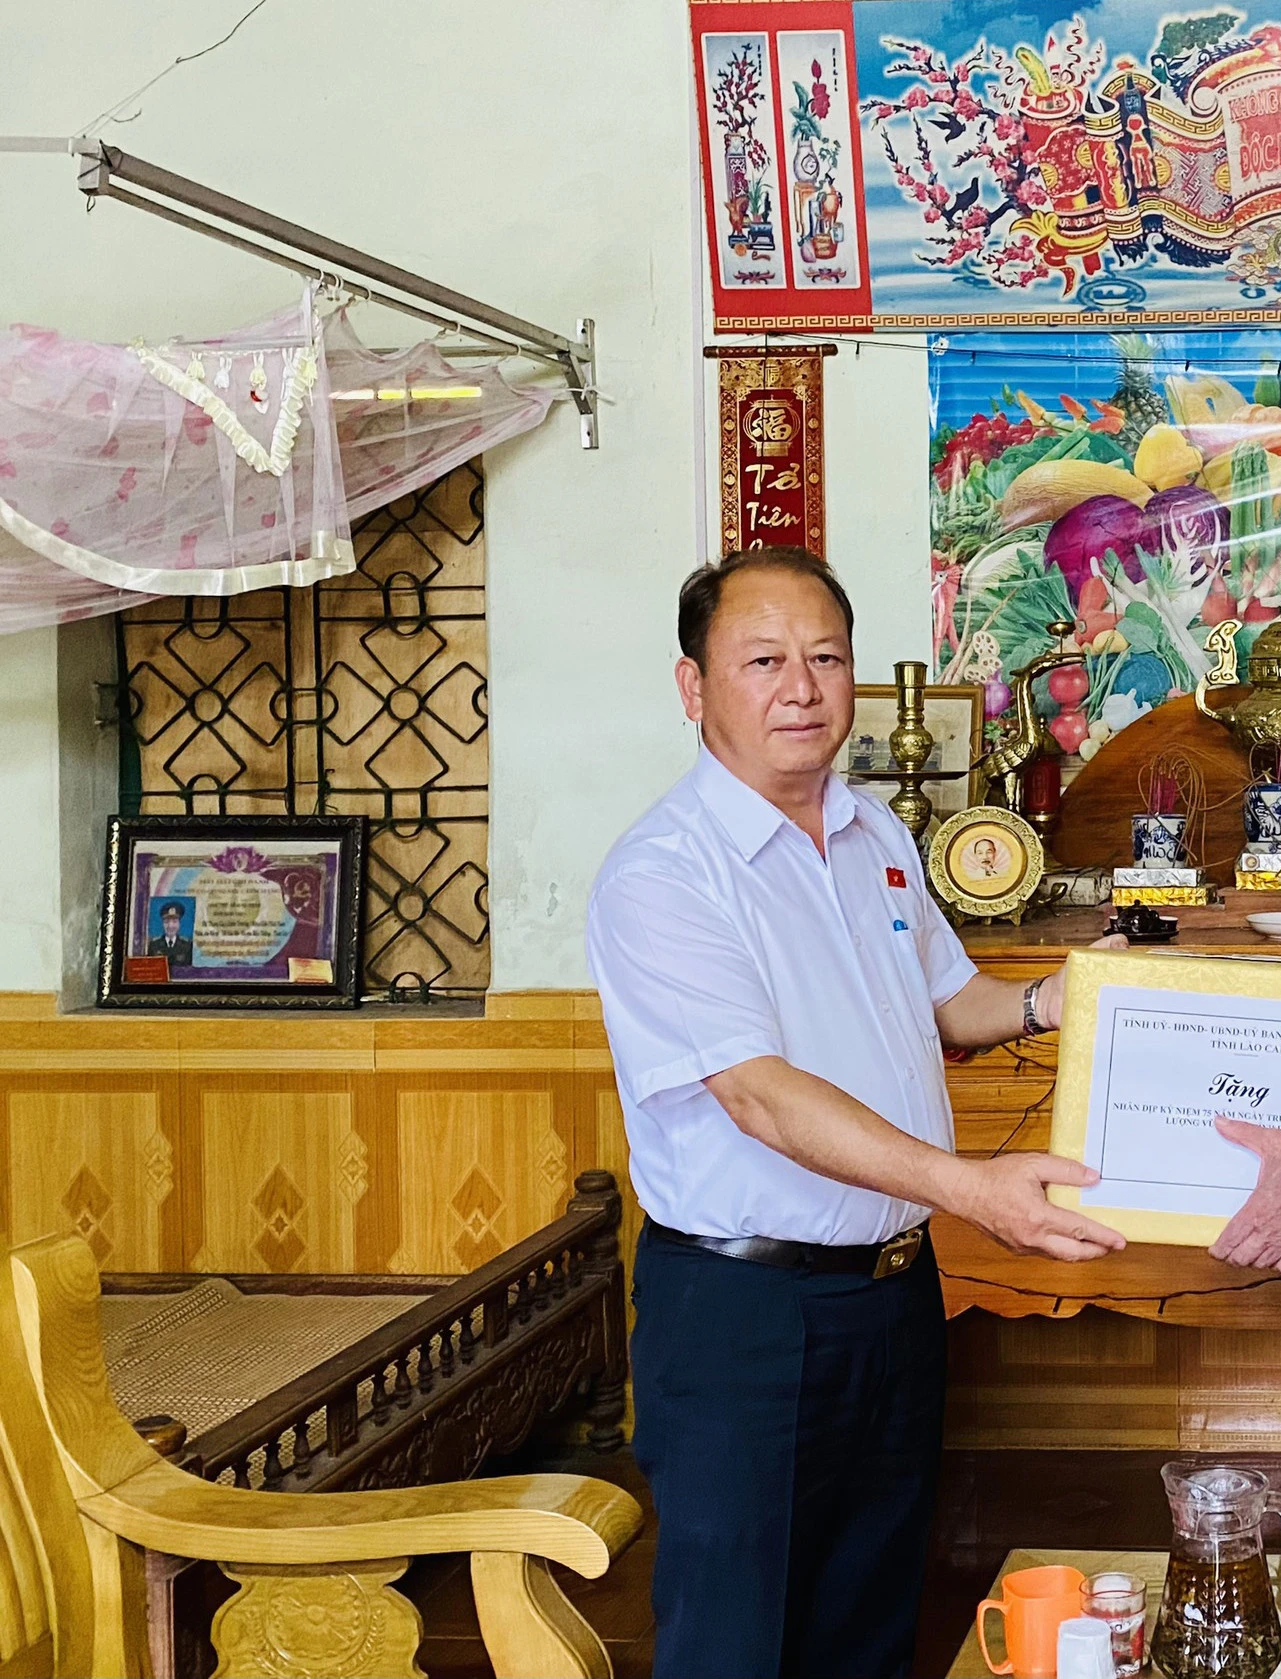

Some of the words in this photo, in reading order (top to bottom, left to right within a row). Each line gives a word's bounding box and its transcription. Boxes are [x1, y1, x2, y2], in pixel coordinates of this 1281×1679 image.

[1229, 89, 1279, 122] KHÔNG
[1240, 131, 1275, 180] ĐỘC
[752, 408, 793, 441] 福
[745, 463, 802, 494] Tổ
[746, 502, 801, 531] Tiên
[1122, 1017, 1149, 1029] TỈNH
[1261, 1029, 1281, 1039] BAN
[1210, 1038, 1236, 1050] TỈNH
[1239, 1040, 1262, 1052] LÀO
[1208, 1072, 1270, 1108] Tặng
[1113, 1101, 1140, 1112] NHÂN
[1142, 1104, 1159, 1114] DỊP
[1176, 1106, 1201, 1118] NIỆM
[1203, 1108, 1212, 1117] 75
[1165, 1116, 1200, 1127] LƯỢNG
